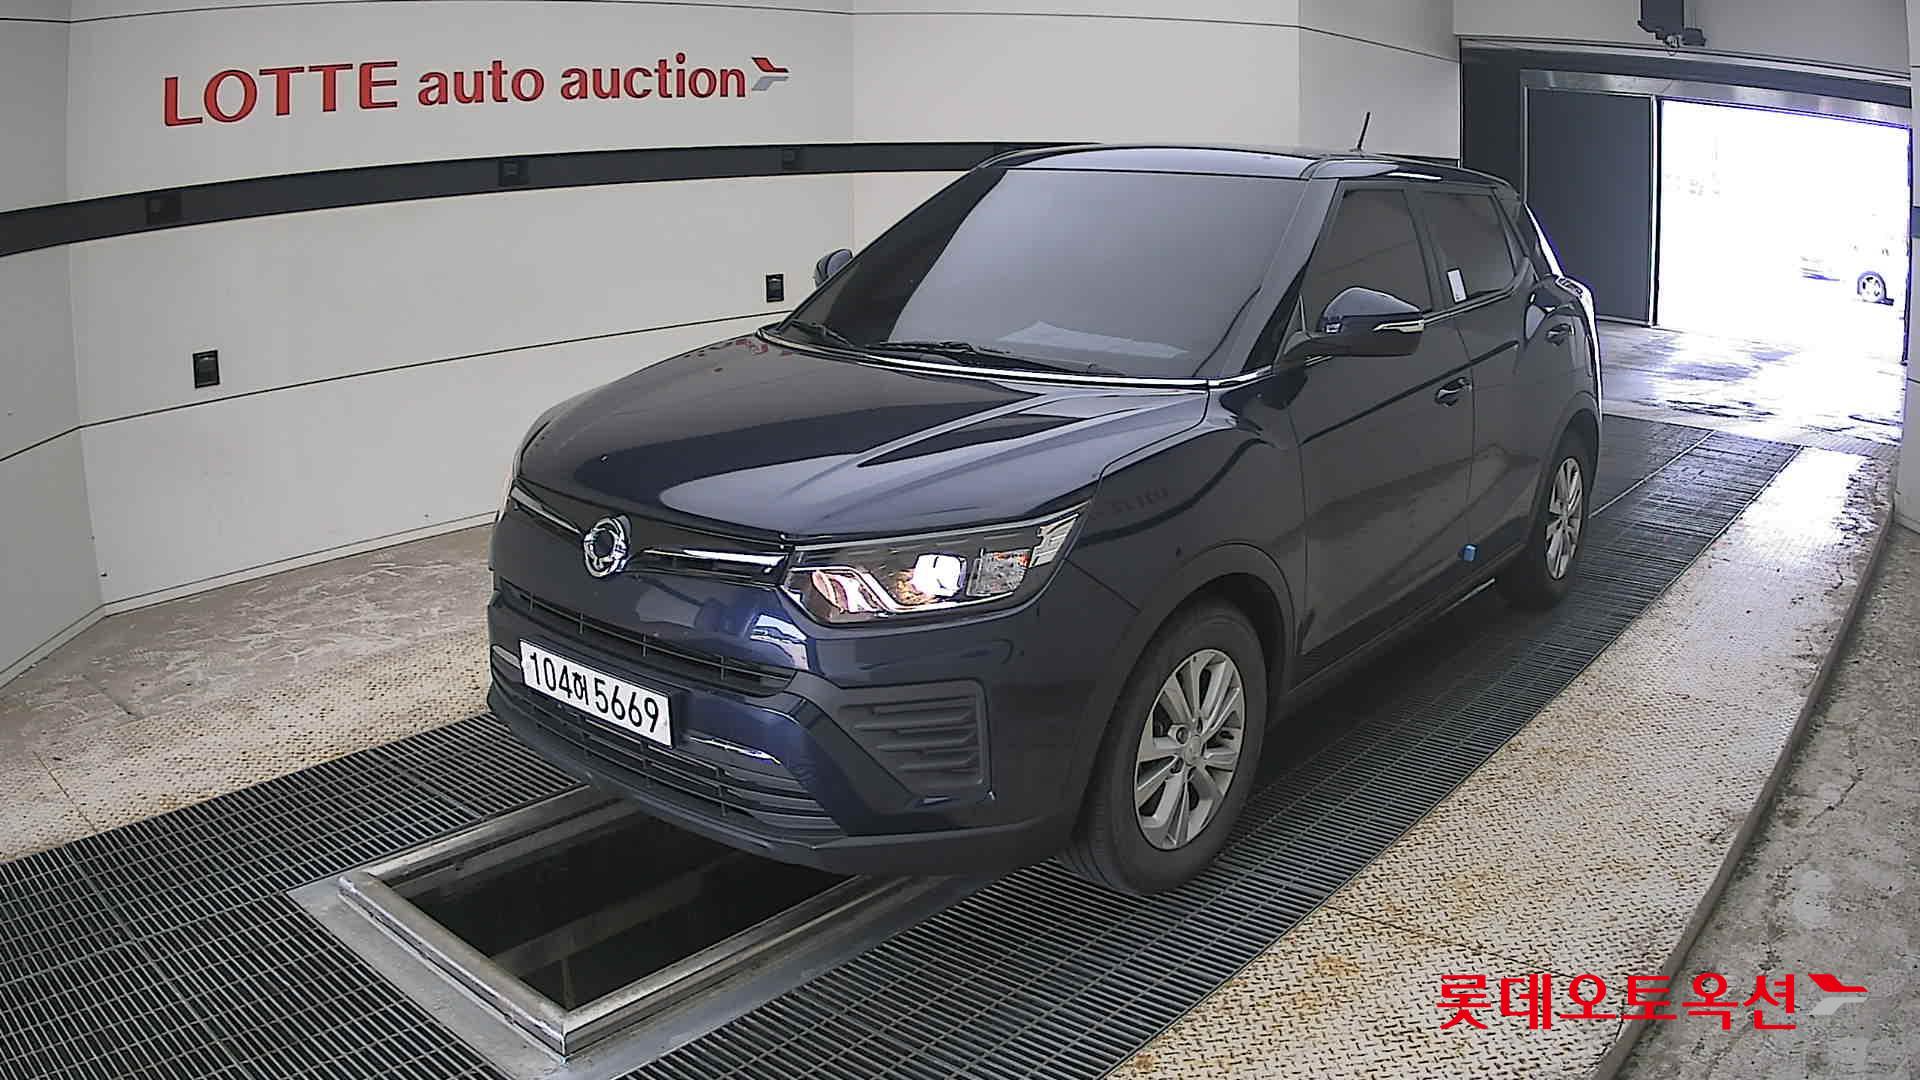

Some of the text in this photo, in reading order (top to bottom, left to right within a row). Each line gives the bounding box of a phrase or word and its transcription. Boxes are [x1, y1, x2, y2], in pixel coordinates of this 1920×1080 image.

[163, 52, 747, 127] LOTTE auto auction
